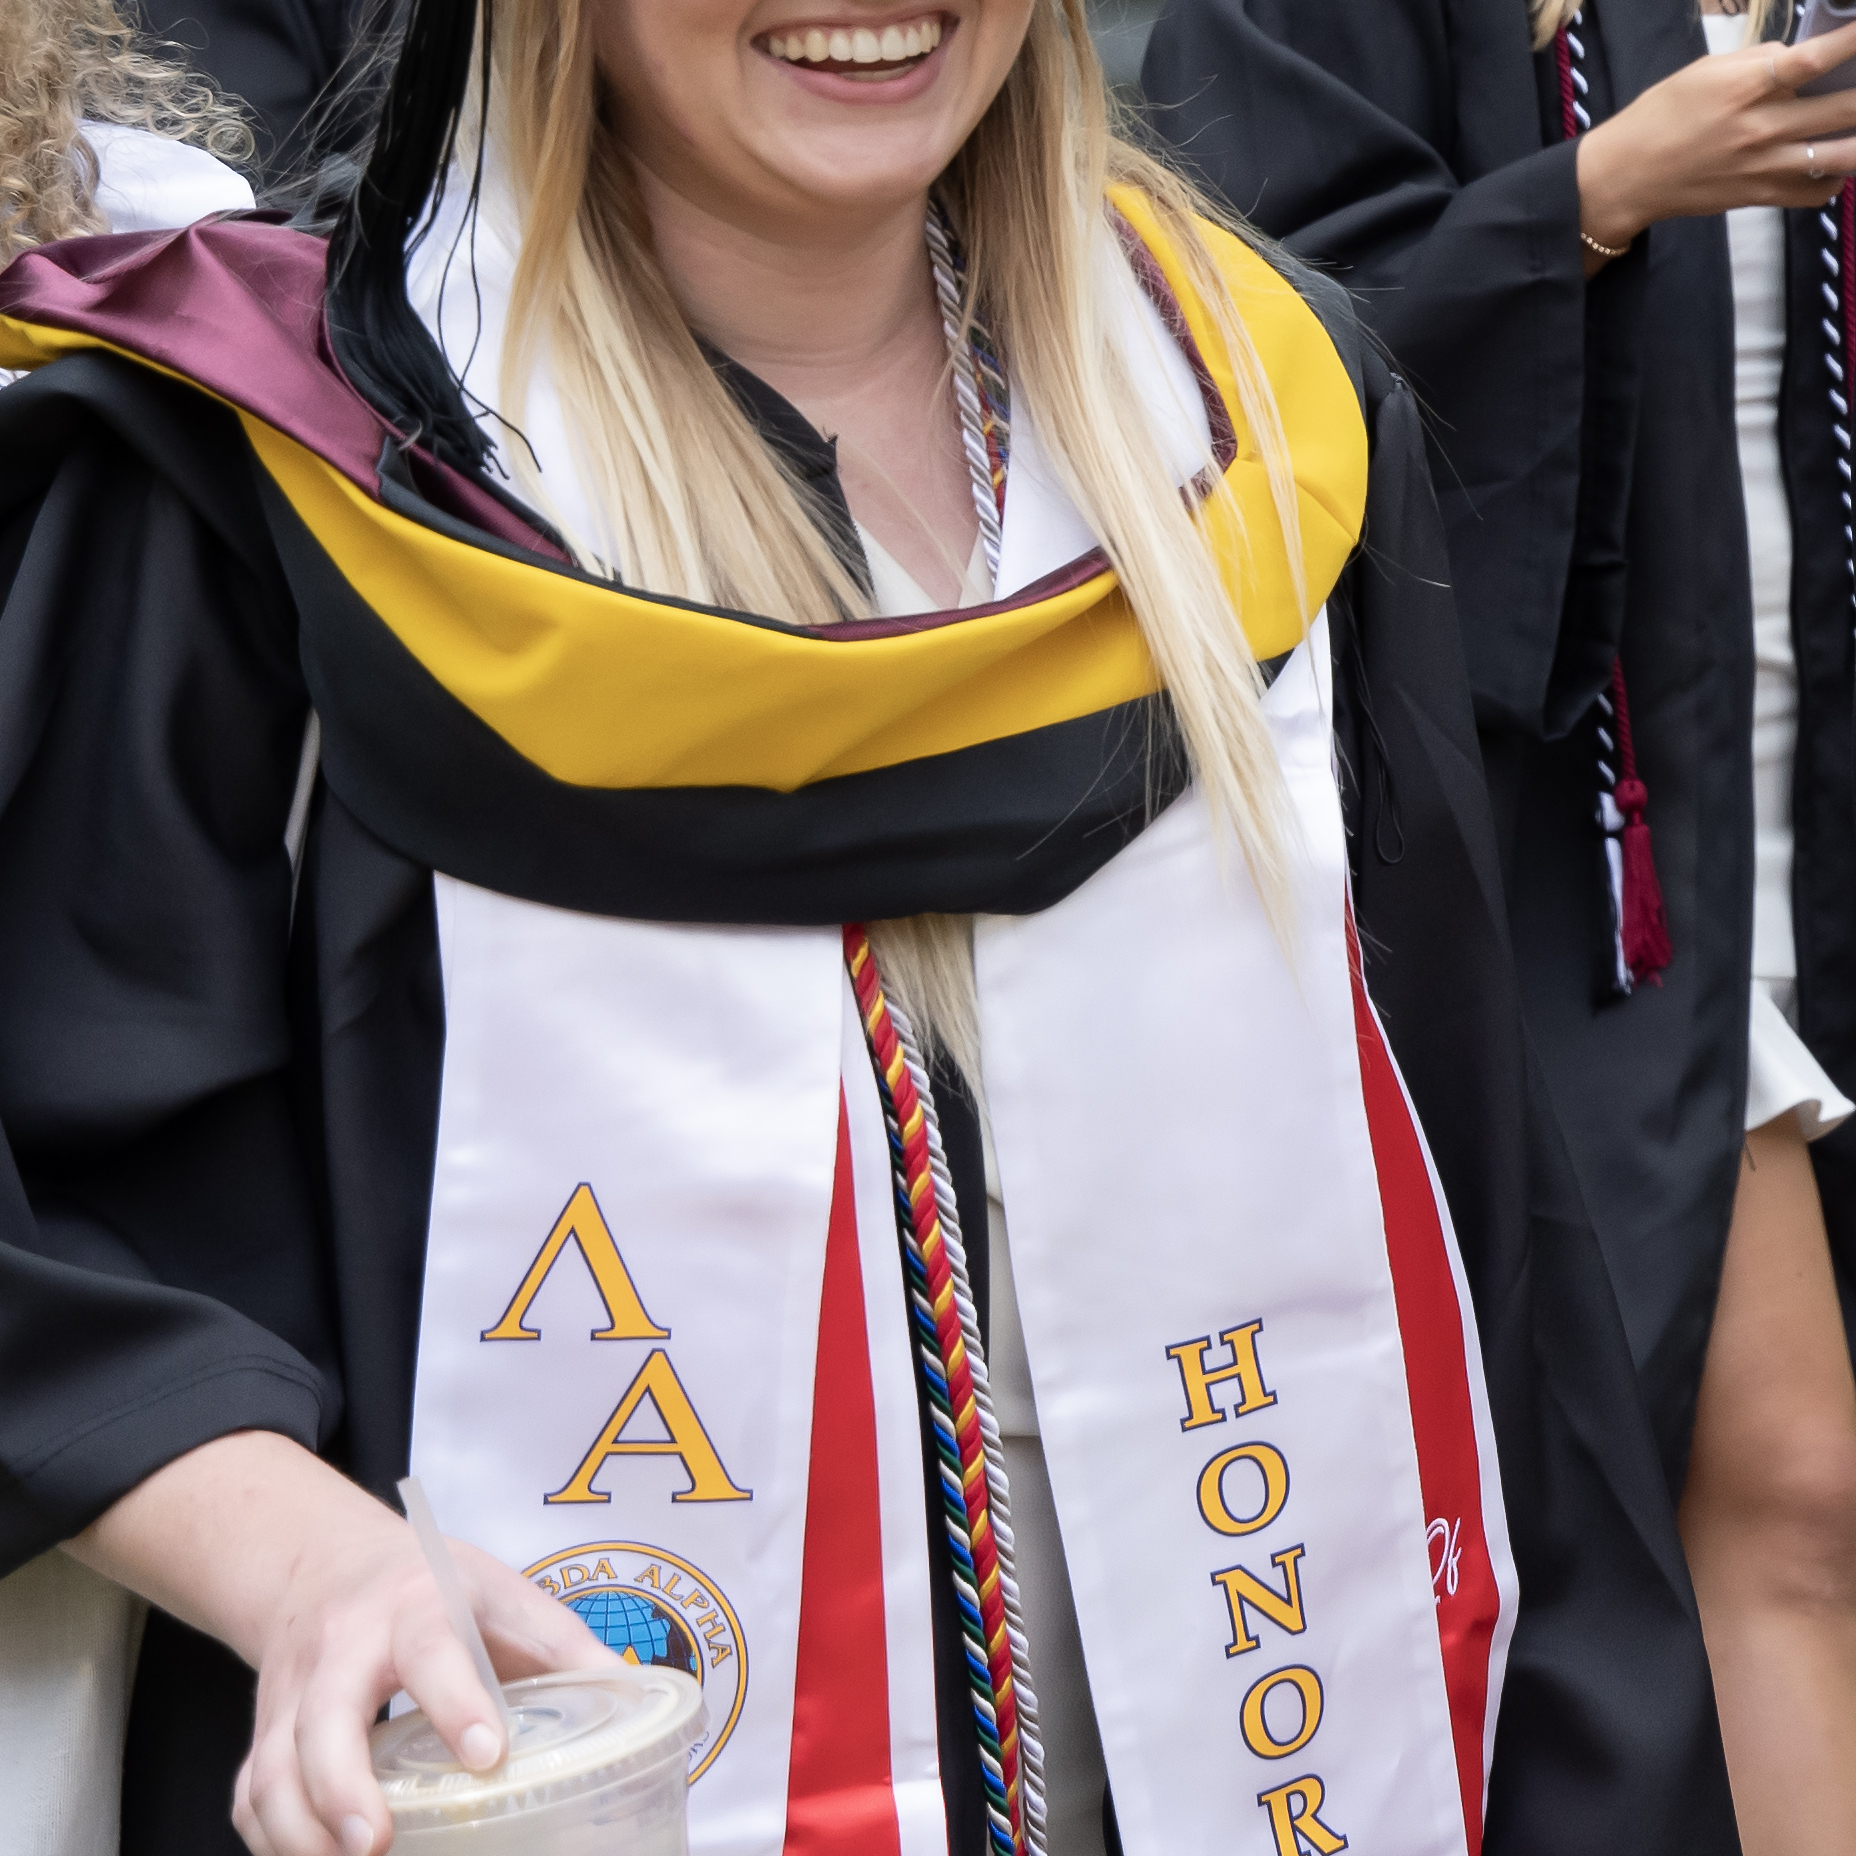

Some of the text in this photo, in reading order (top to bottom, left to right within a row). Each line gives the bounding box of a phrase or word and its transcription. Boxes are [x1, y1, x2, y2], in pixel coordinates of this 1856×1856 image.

[536, 1557, 734, 1670] BDA ALPHA
[1164, 1317, 1349, 1856] HONOR
